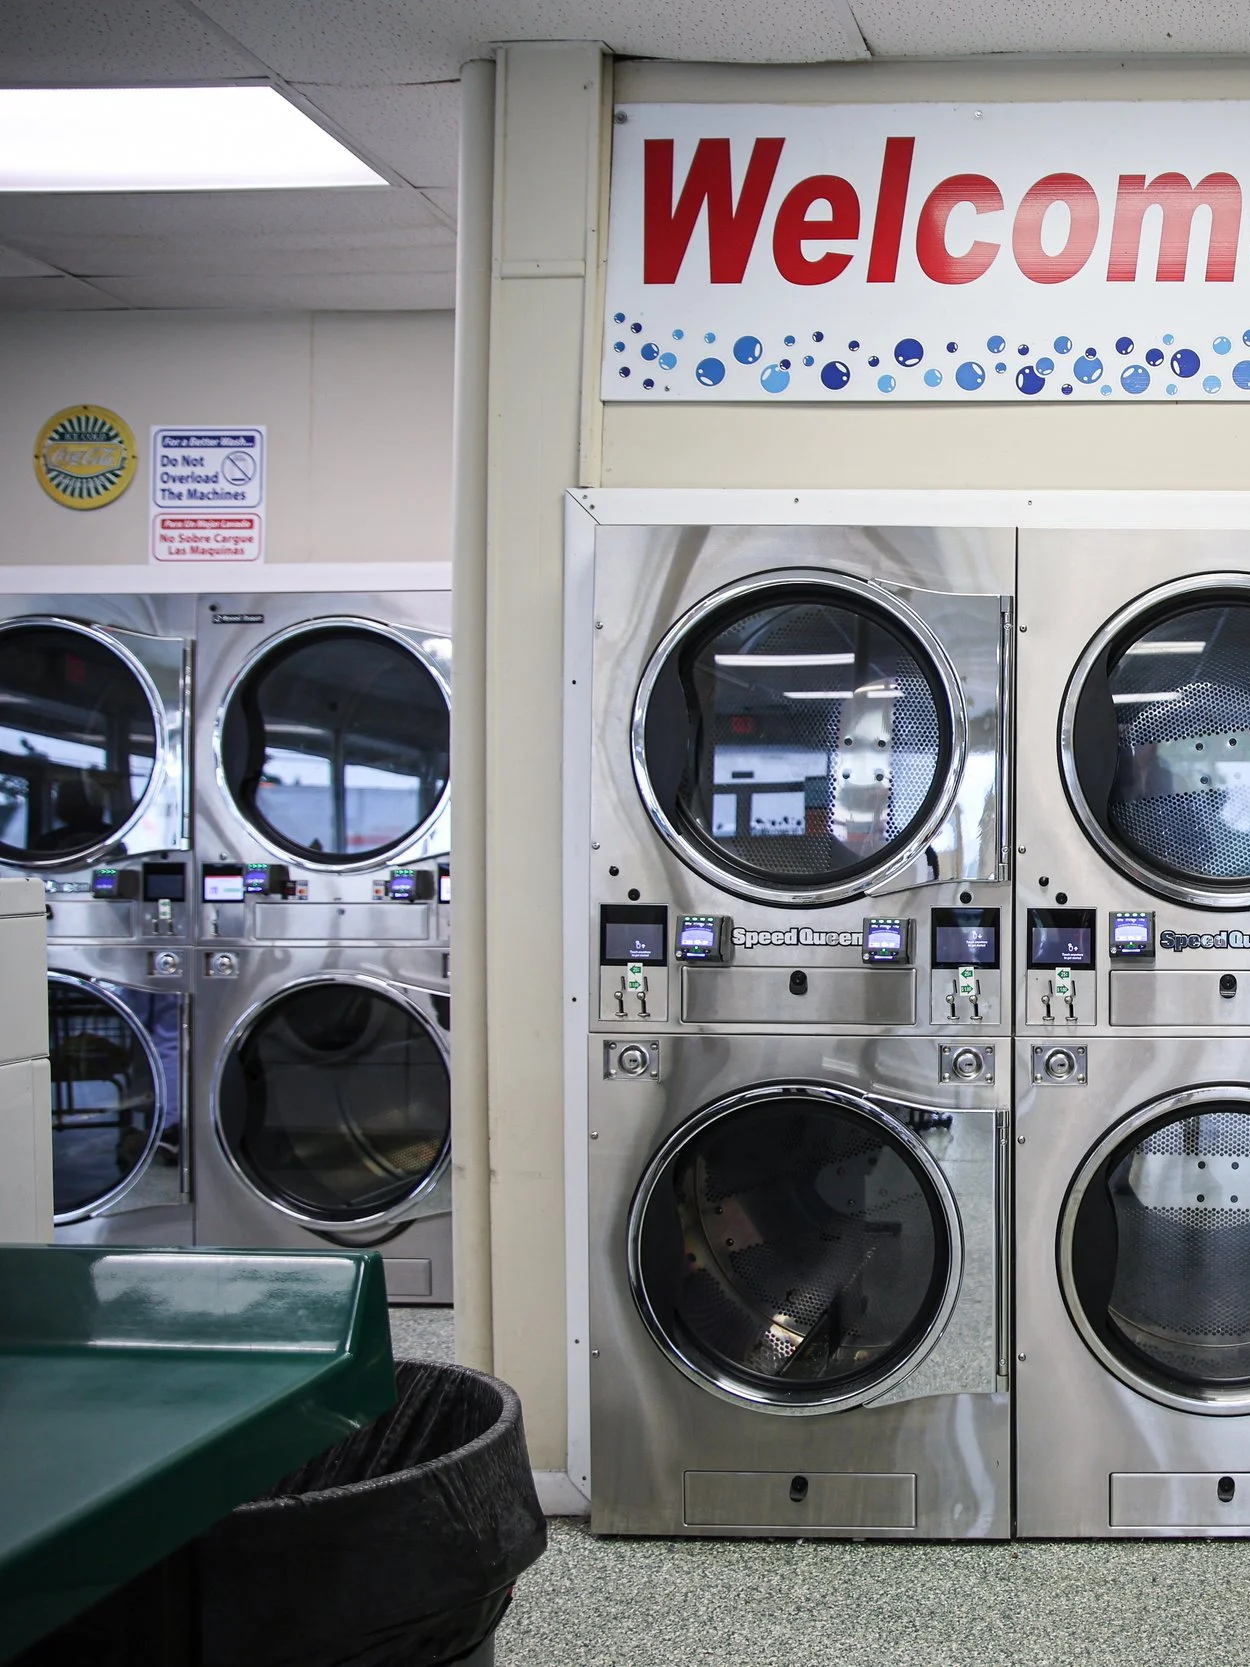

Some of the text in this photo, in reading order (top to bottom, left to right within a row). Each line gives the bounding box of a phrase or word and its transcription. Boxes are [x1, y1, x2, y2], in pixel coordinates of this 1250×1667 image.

[163, 436, 180, 447] For
[180, 438, 188, 447] a
[189, 436, 219, 447] Better
[161, 455, 204, 468] Do Not
[161, 471, 219, 484] Overload
[161, 487, 247, 500] The Machines
[160, 533, 254, 546] No Sobre Cargue
[168, 546, 245, 556] Las Maquinas
[732, 927, 799, 949] Speed
[799, 927, 863, 946] Queen
[1160, 929, 1228, 952] Speed
